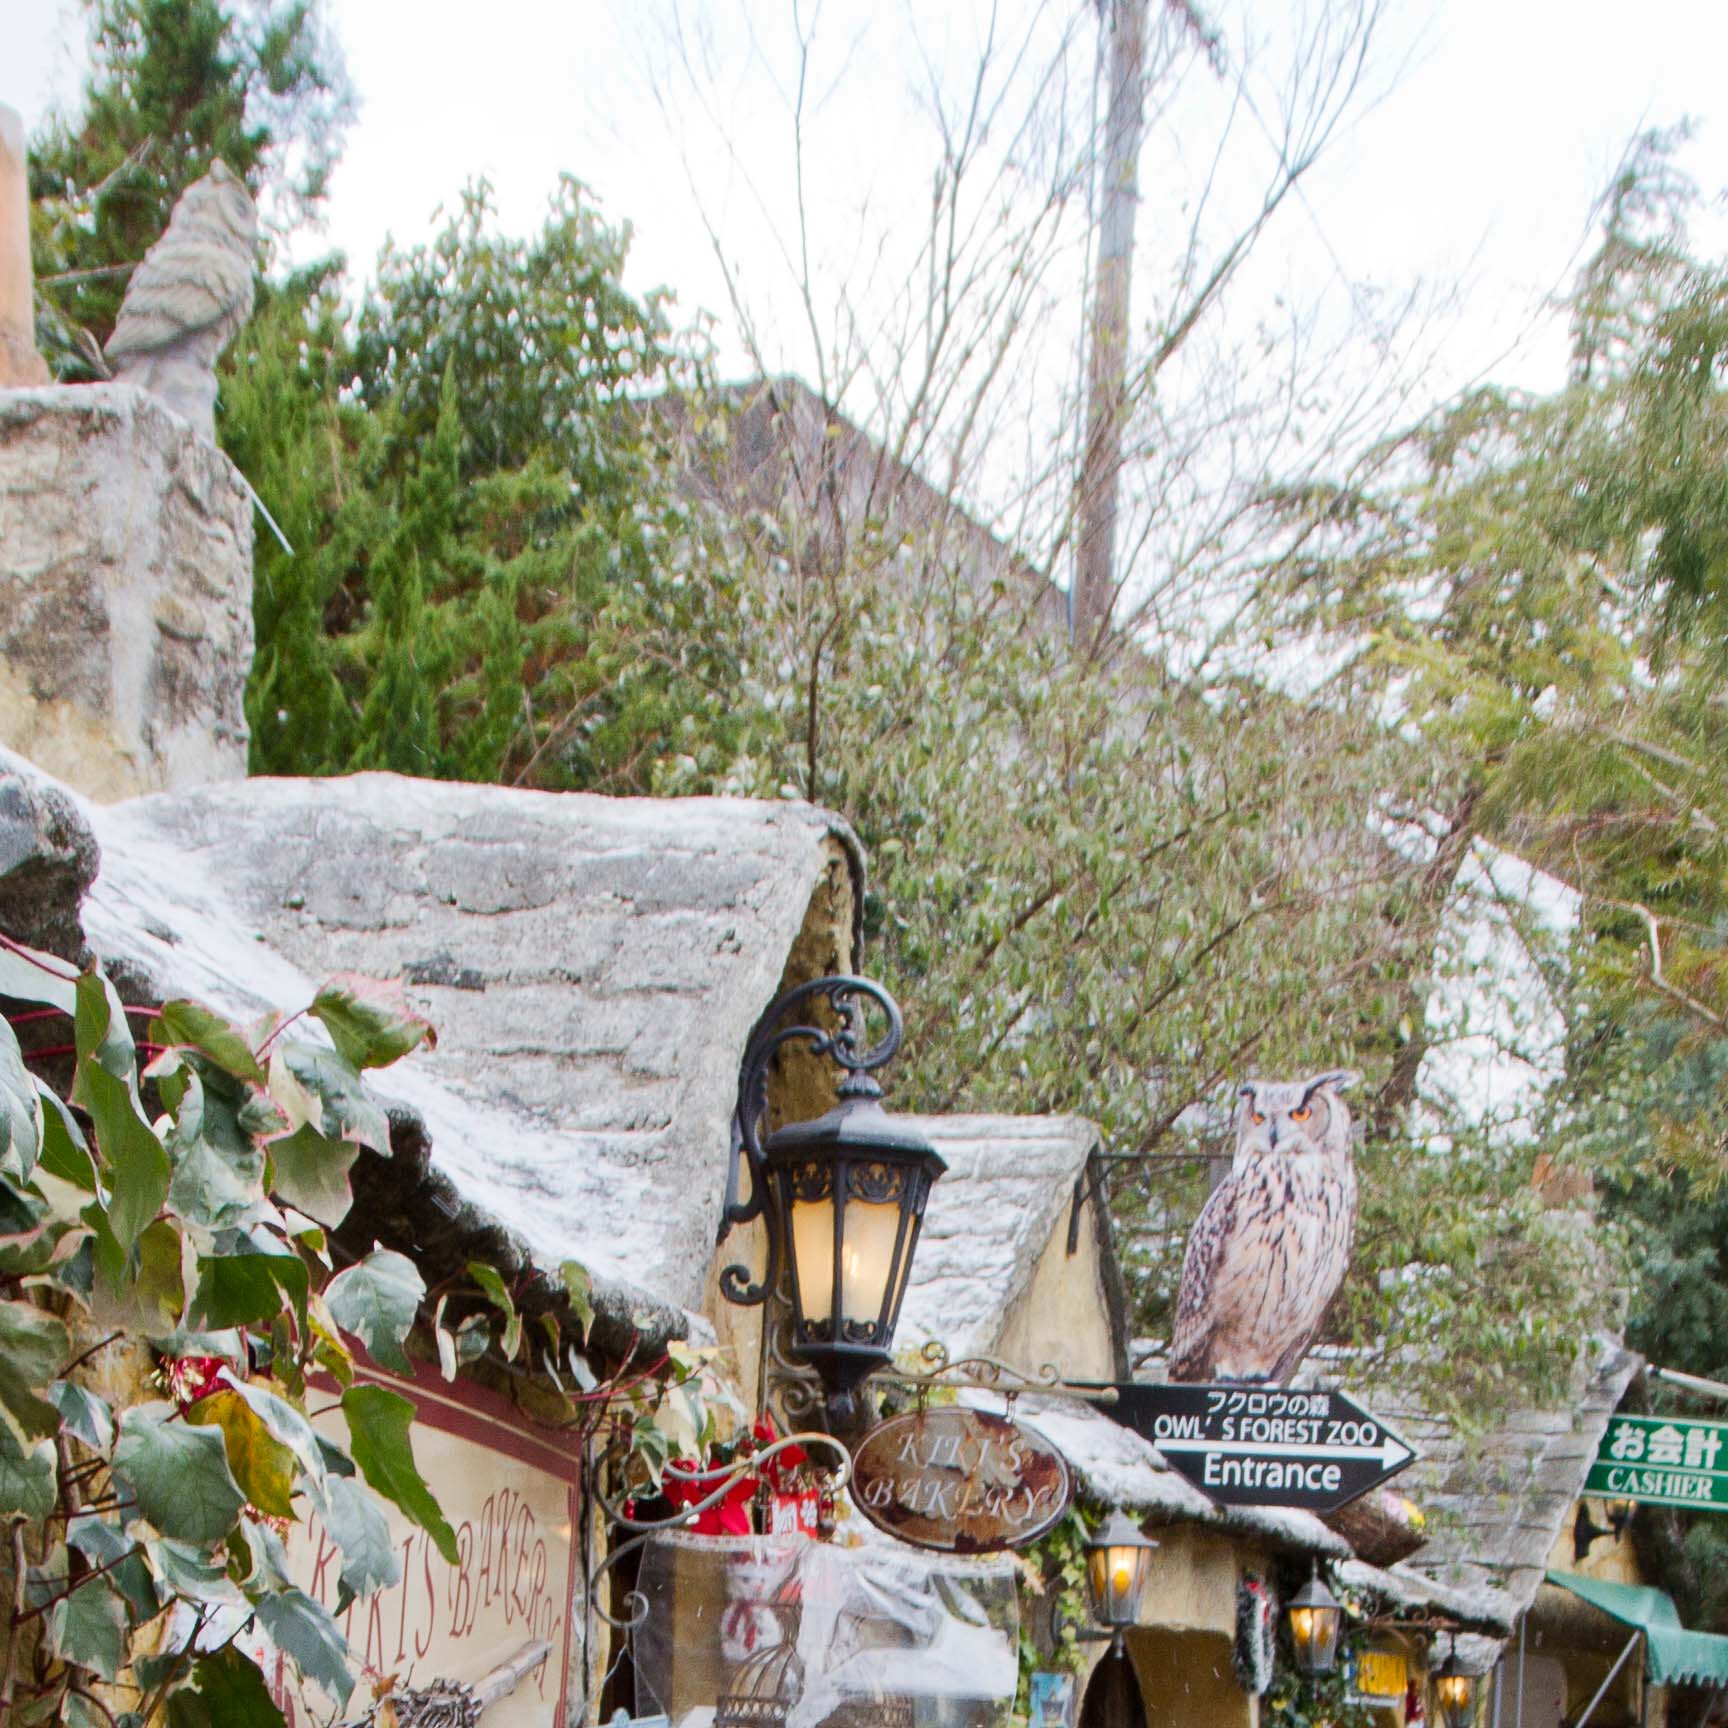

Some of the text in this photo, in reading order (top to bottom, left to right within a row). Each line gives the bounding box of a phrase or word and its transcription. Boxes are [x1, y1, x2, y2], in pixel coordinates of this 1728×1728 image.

[1206, 1390, 1330, 1417] フクロウの森
[1239, 1417, 1321, 1445] FOREST
[1327, 1421, 1378, 1447] ZOO
[1610, 1421, 1723, 1470] お会計
[897, 1431, 1024, 1474] KIKI'S
[1203, 1452, 1342, 1491] Entrance
[863, 1476, 1054, 1526] BAKERY
[1607, 1467, 1713, 1500] CASHIER
